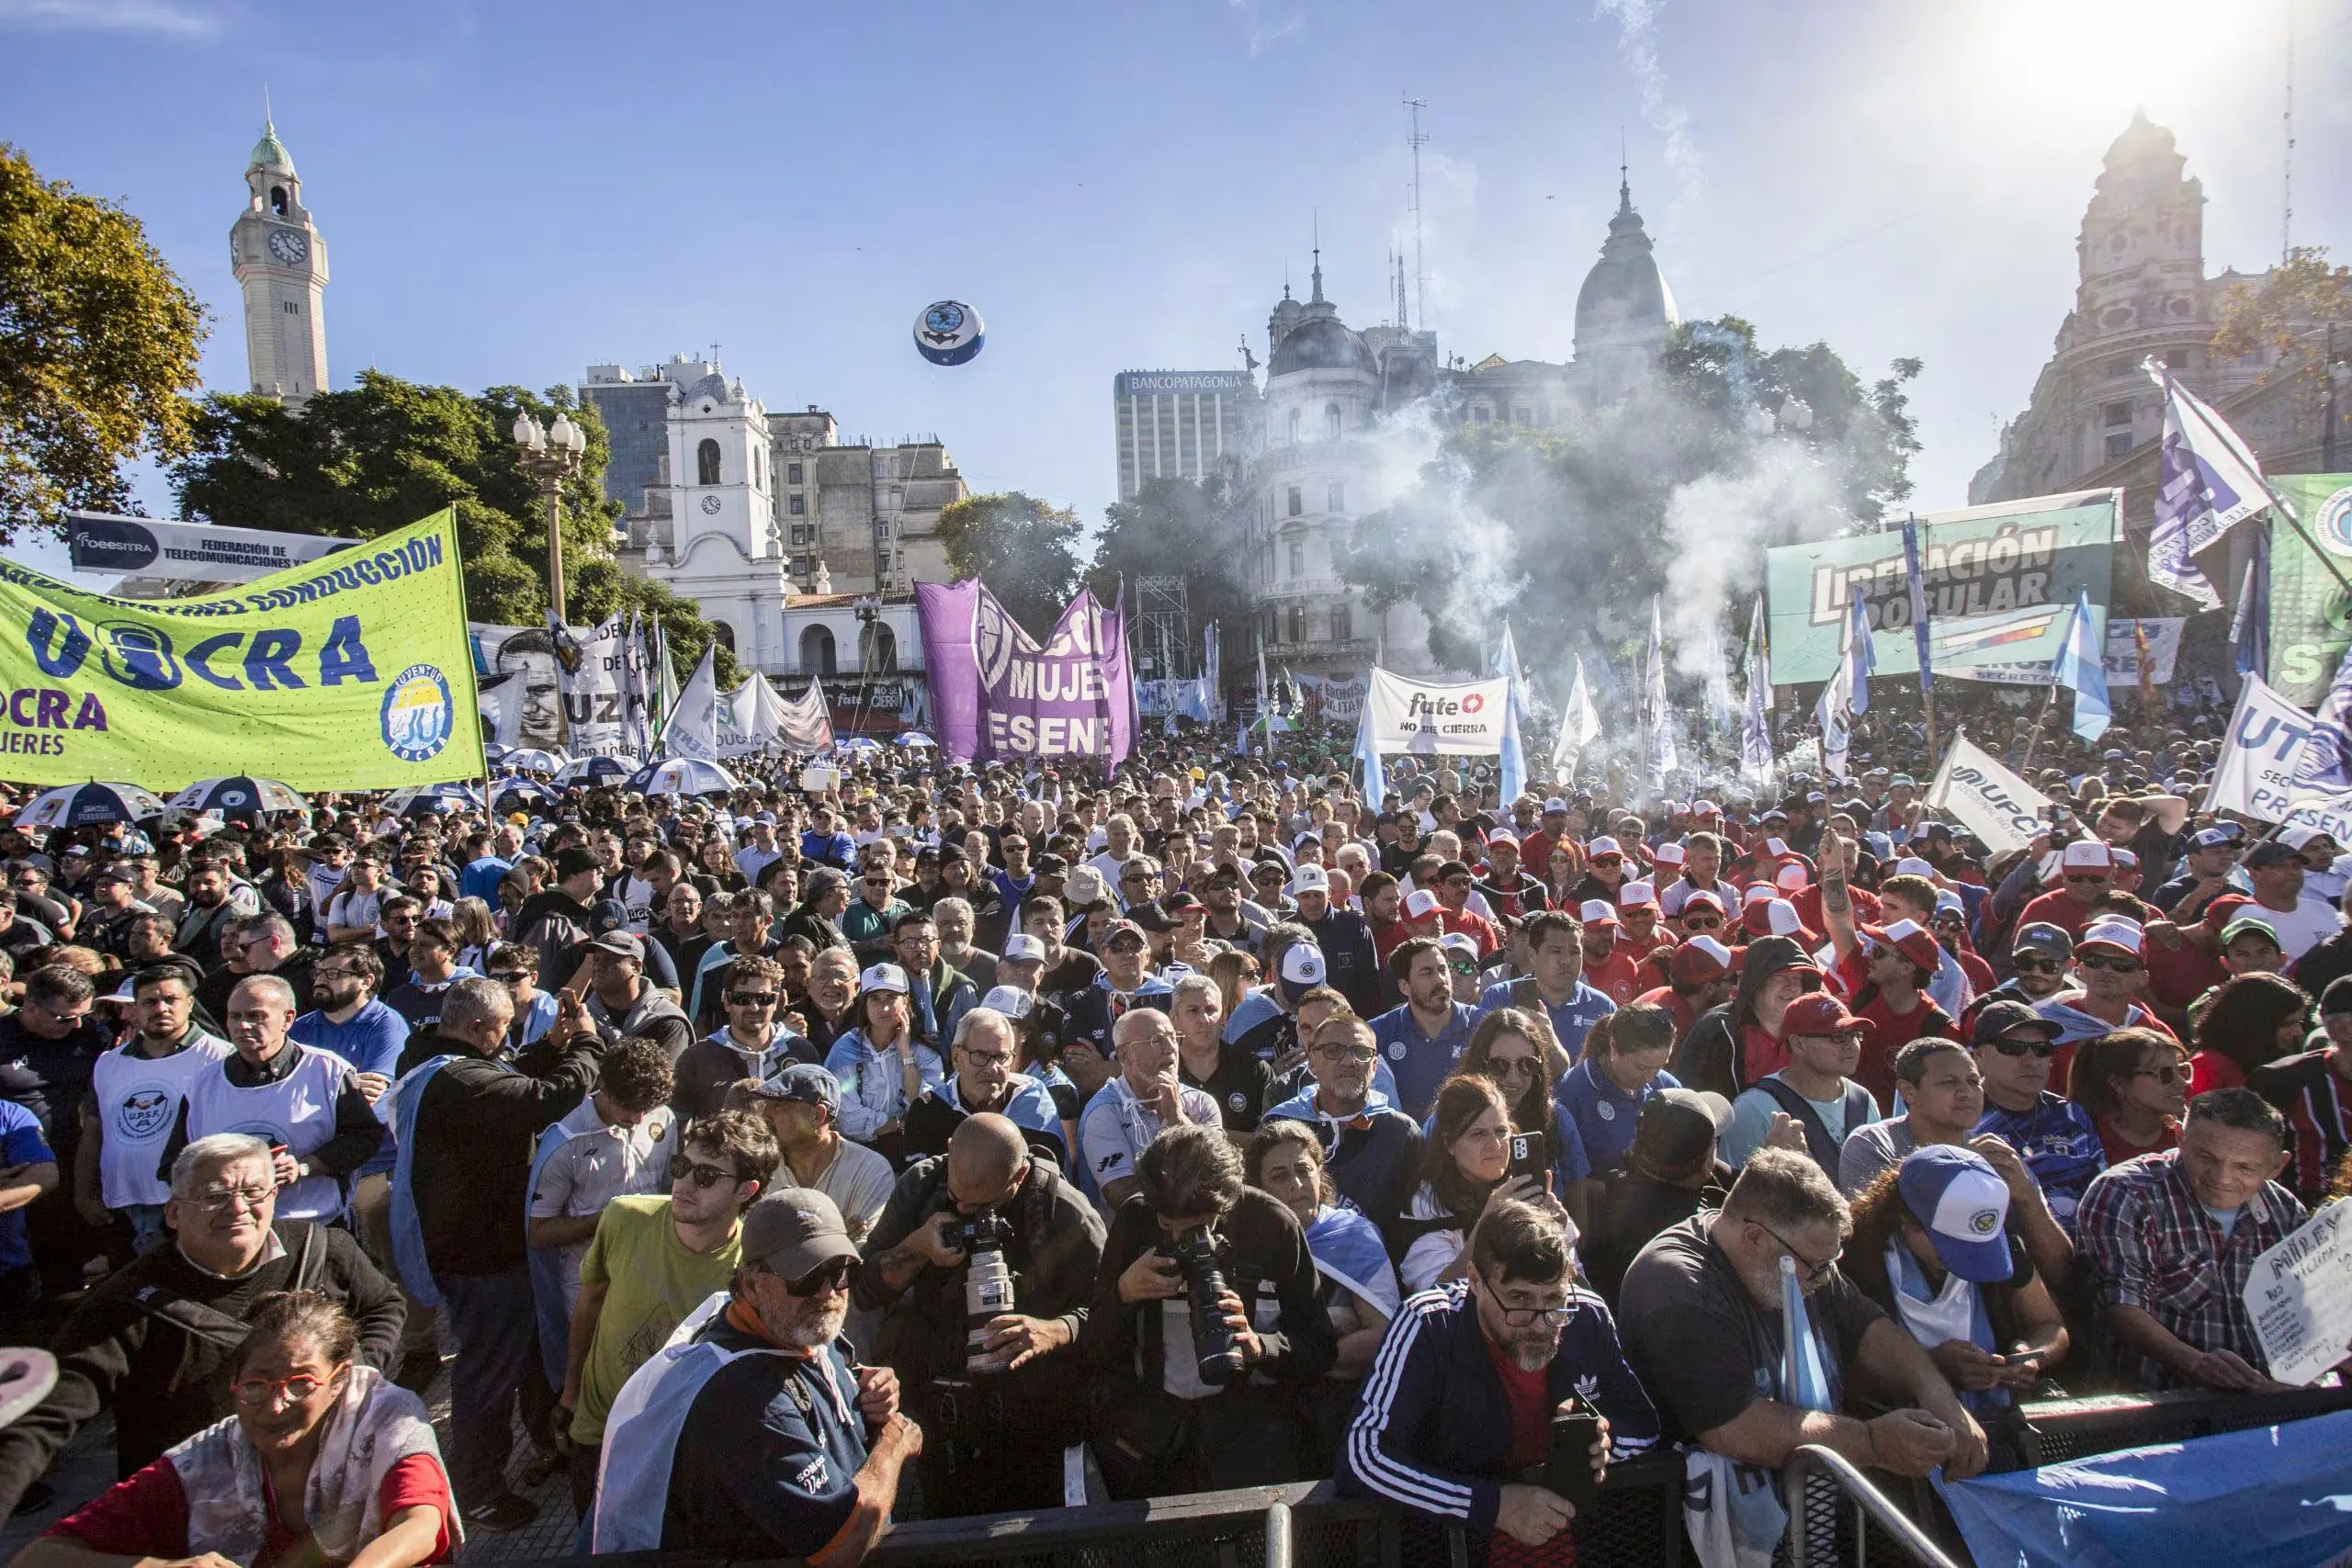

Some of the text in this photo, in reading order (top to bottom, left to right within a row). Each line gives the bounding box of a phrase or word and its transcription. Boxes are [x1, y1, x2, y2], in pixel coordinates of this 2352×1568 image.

[164, 547, 291, 569] TELECOMUNICACIONES
[201, 538, 287, 557] FEDERACIÓN DE
[246, 533, 444, 612] CONDUCCIÓN
[1812, 522, 2058, 626] LIBEACIÓN
[1838, 573, 2049, 654] POULAR
[395, 665, 443, 690] JUVENTUD
[837, 693, 862, 707] fate
[1408, 693, 1459, 717] fate
[1399, 721, 1418, 732] NO
[1442, 723, 1487, 734] CIERRA
[390, 736, 447, 761] UOCRA
[796, 1454, 826, 1483] SOMOS
